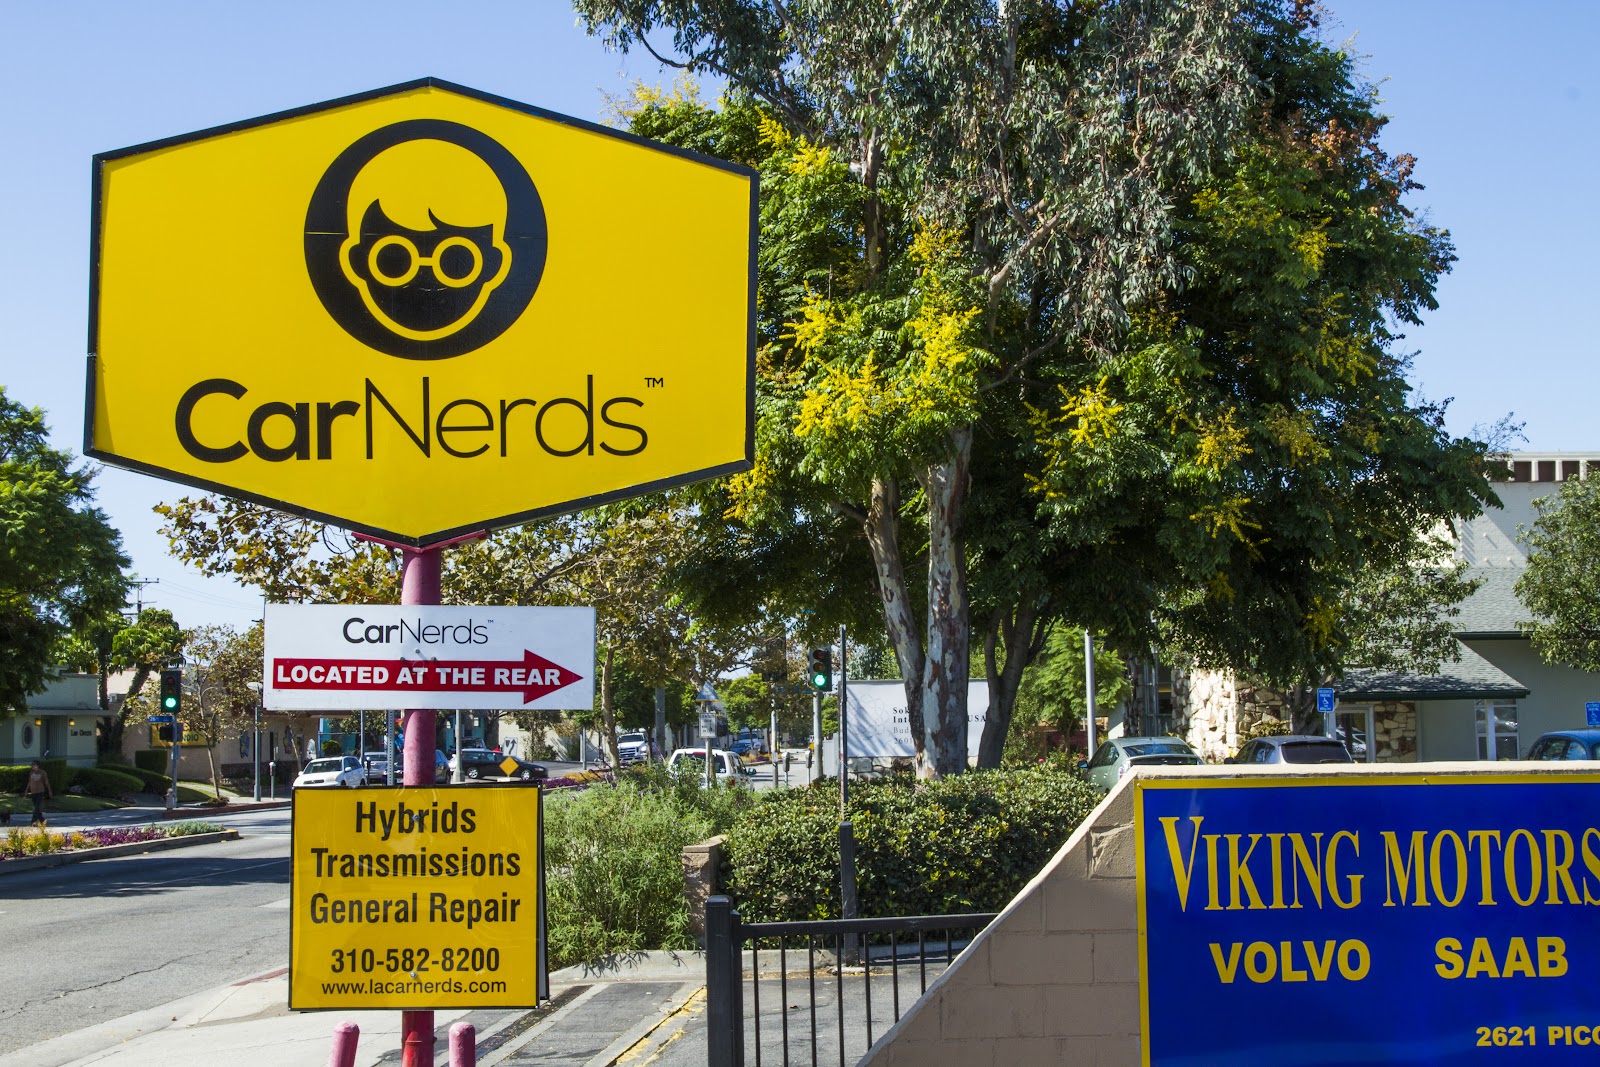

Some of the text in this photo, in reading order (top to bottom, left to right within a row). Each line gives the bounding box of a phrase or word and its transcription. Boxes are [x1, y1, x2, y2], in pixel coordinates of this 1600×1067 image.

[175, 374, 648, 463] CarNerds
[342, 617, 489, 644] CarNerds
[277, 665, 561, 686] LOCATED AT THE REAR
[355, 801, 476, 841] Hybrids
[310, 847, 521, 877] Transmissions
[1158, 816, 1364, 912] VIKING
[310, 892, 521, 929] General Repair
[331, 947, 500, 973] 310-582-8200
[1209, 937, 1569, 984] VOLVO SAAB
[321, 978, 507, 994] www.lacarnerds.com
[1476, 1026, 1537, 1047] 2621
